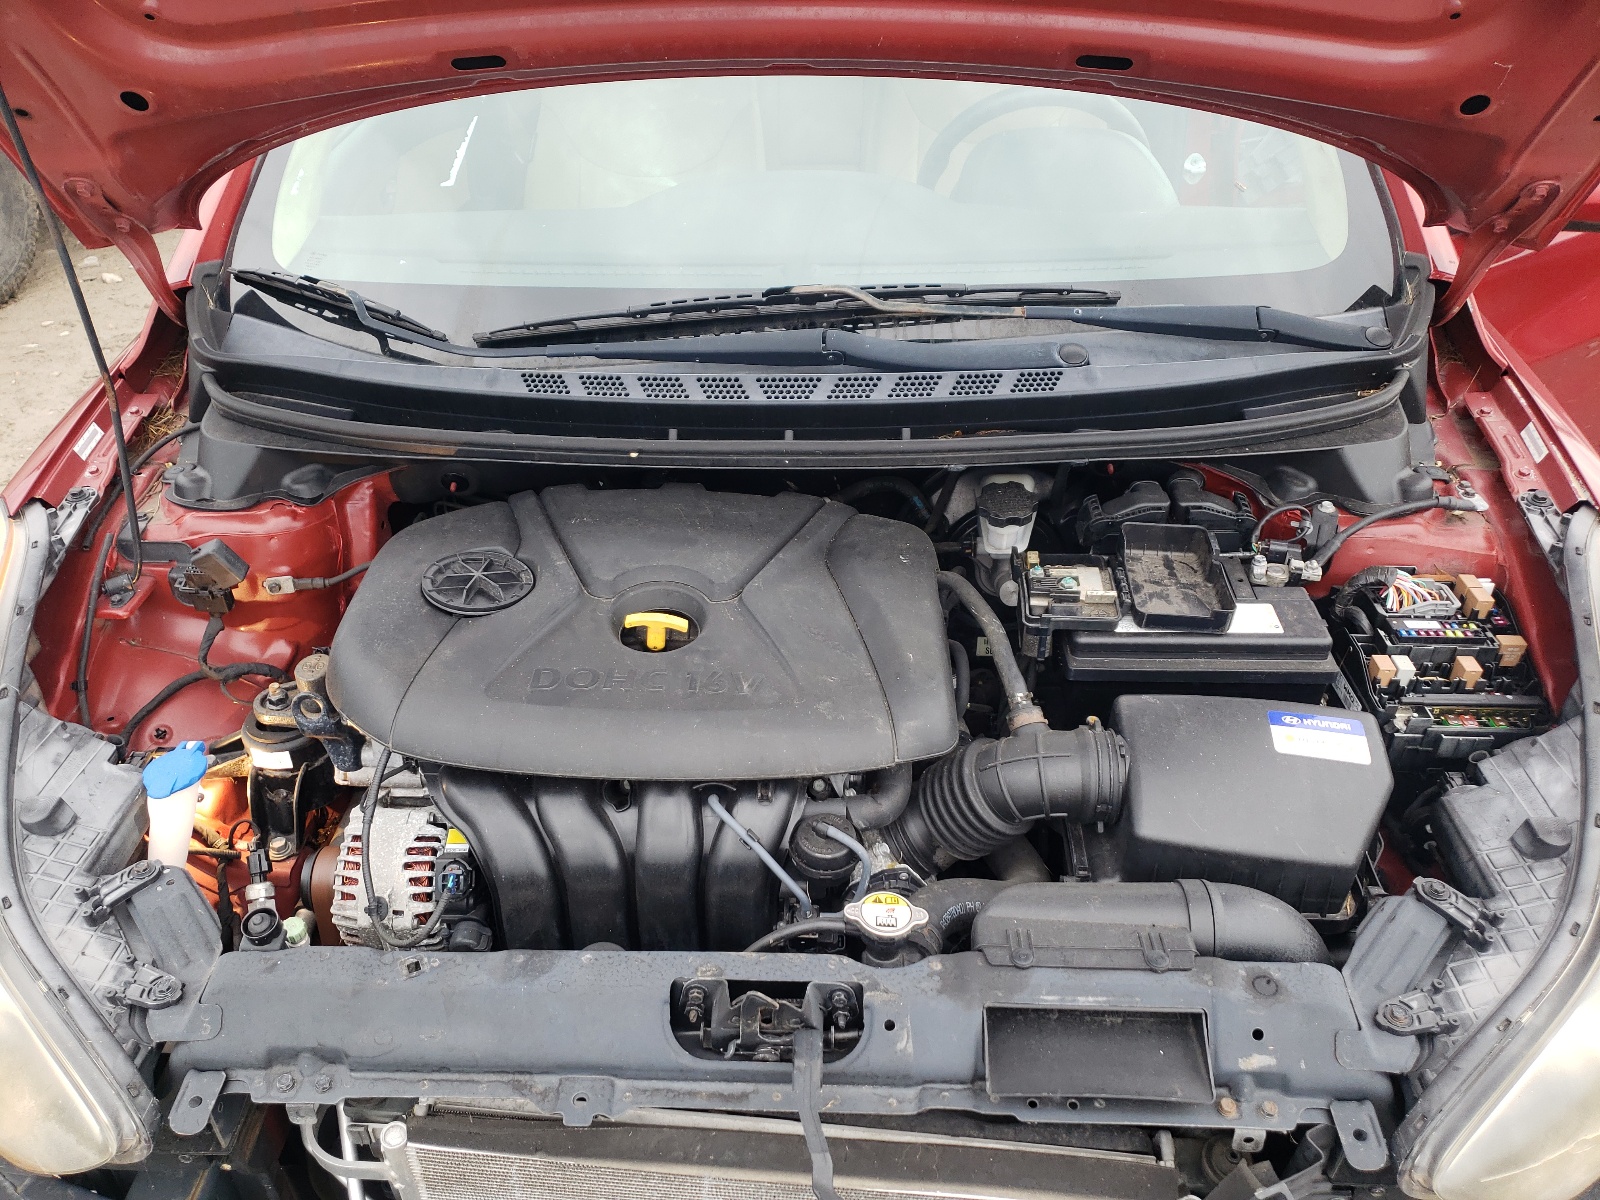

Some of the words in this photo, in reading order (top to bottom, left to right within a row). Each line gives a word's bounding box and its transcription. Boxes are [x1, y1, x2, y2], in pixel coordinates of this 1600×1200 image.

[529, 667, 668, 691] DOHC
[686, 670, 766, 695] 16V
[1302, 718, 1352, 731] HYUNDAI
